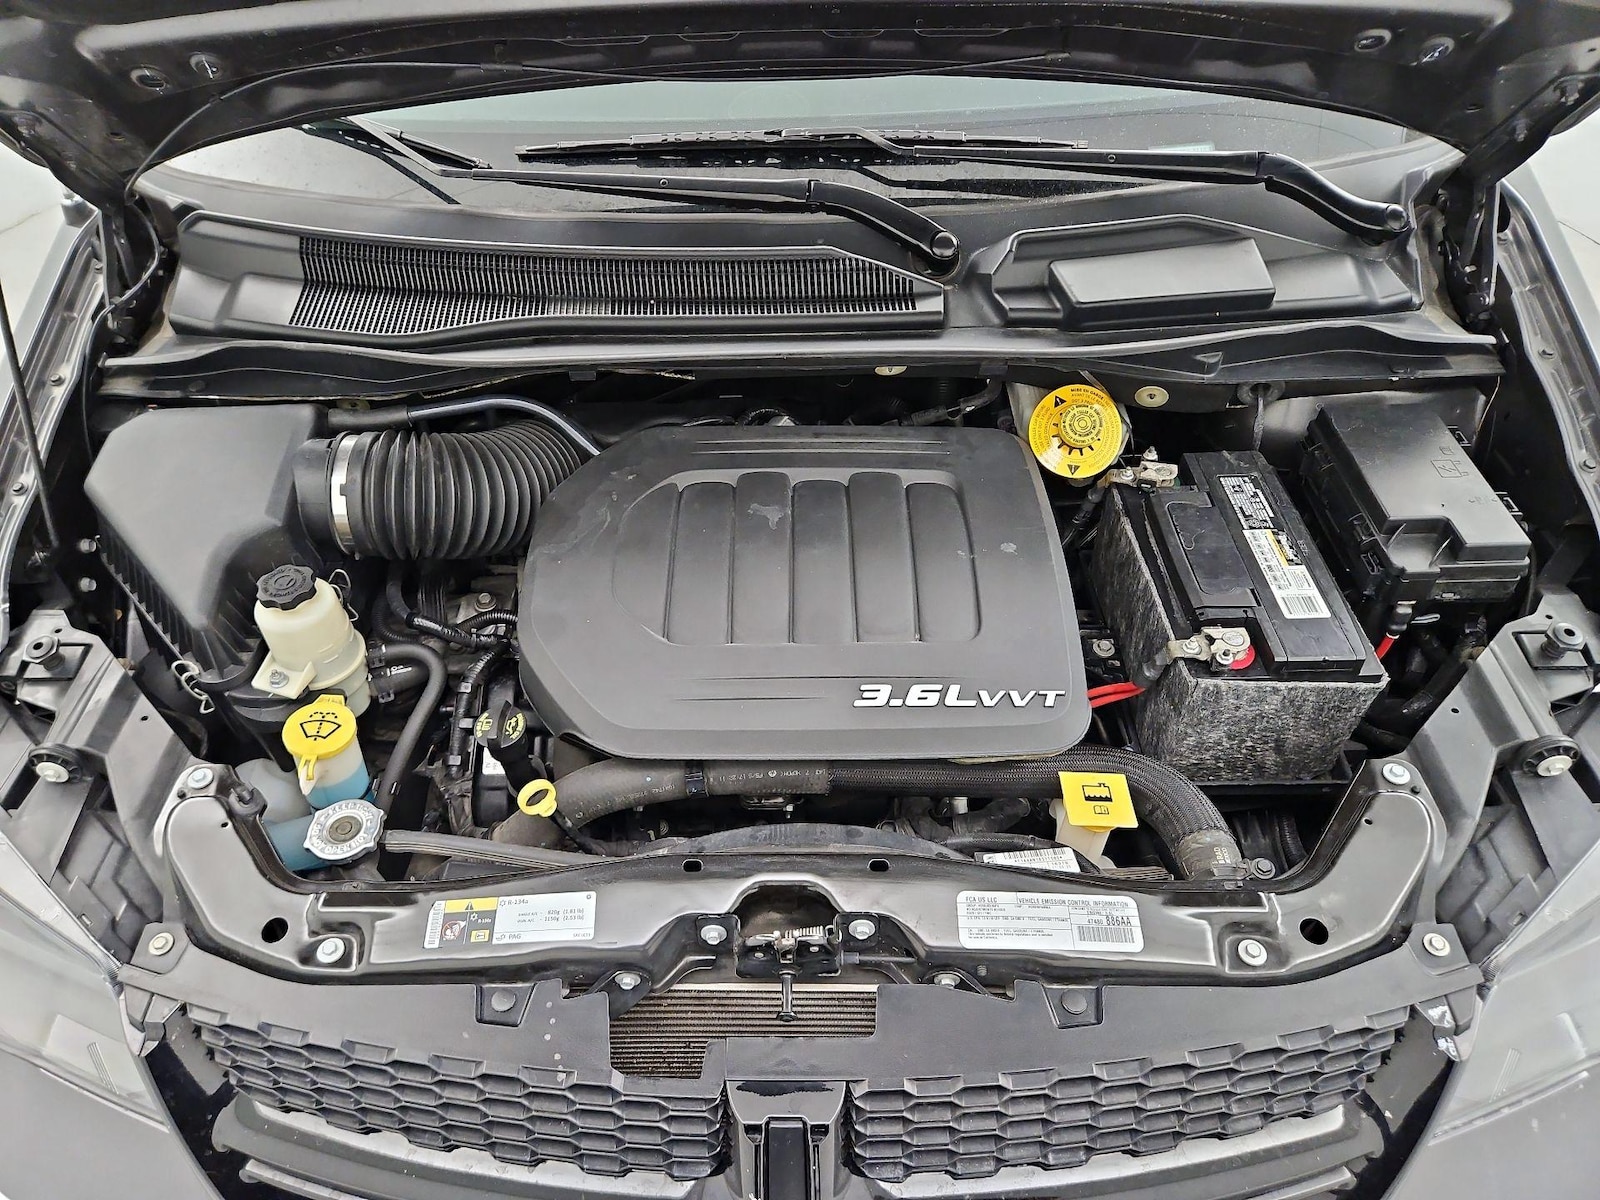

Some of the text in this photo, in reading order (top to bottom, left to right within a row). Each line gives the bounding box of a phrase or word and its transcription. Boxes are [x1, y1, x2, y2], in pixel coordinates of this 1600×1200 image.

[853, 684, 1066, 708] 3.6L VVT
[1067, 899, 1091, 907] CONTROL
[1093, 900, 1129, 908] INFORMATION
[1105, 915, 1132, 926] 886AA
[508, 932, 521, 941] PAG
